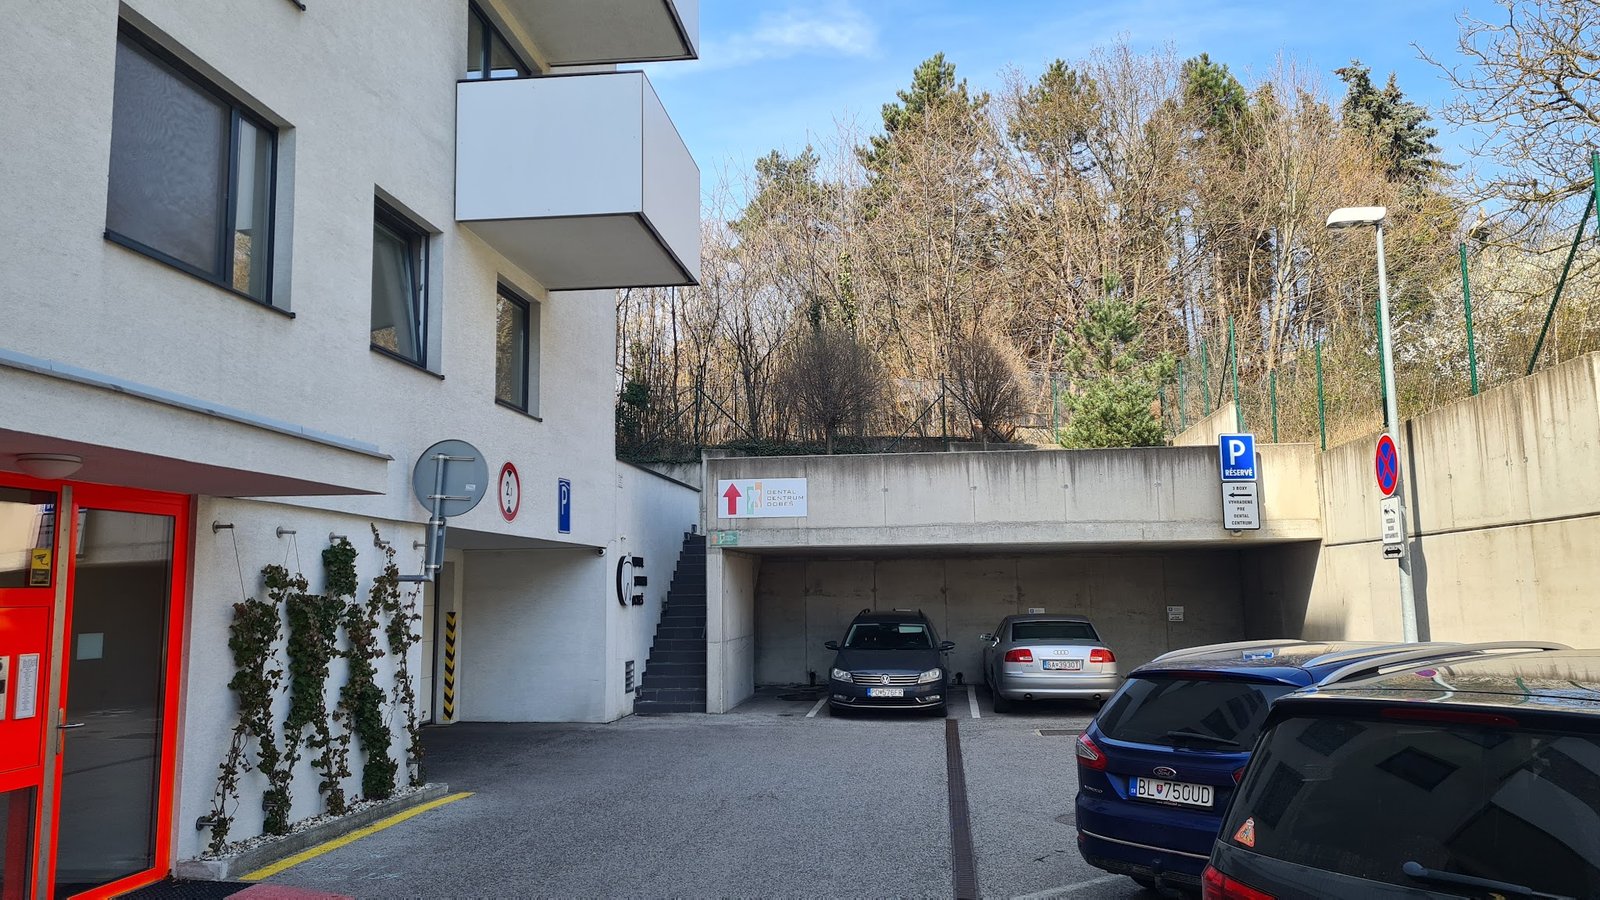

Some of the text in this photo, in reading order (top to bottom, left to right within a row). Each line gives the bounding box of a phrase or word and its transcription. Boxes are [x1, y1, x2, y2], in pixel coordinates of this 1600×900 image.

[1229, 439, 1246, 465] P
[561, 485, 568, 515] P
[1138, 779, 1154, 797] BL
